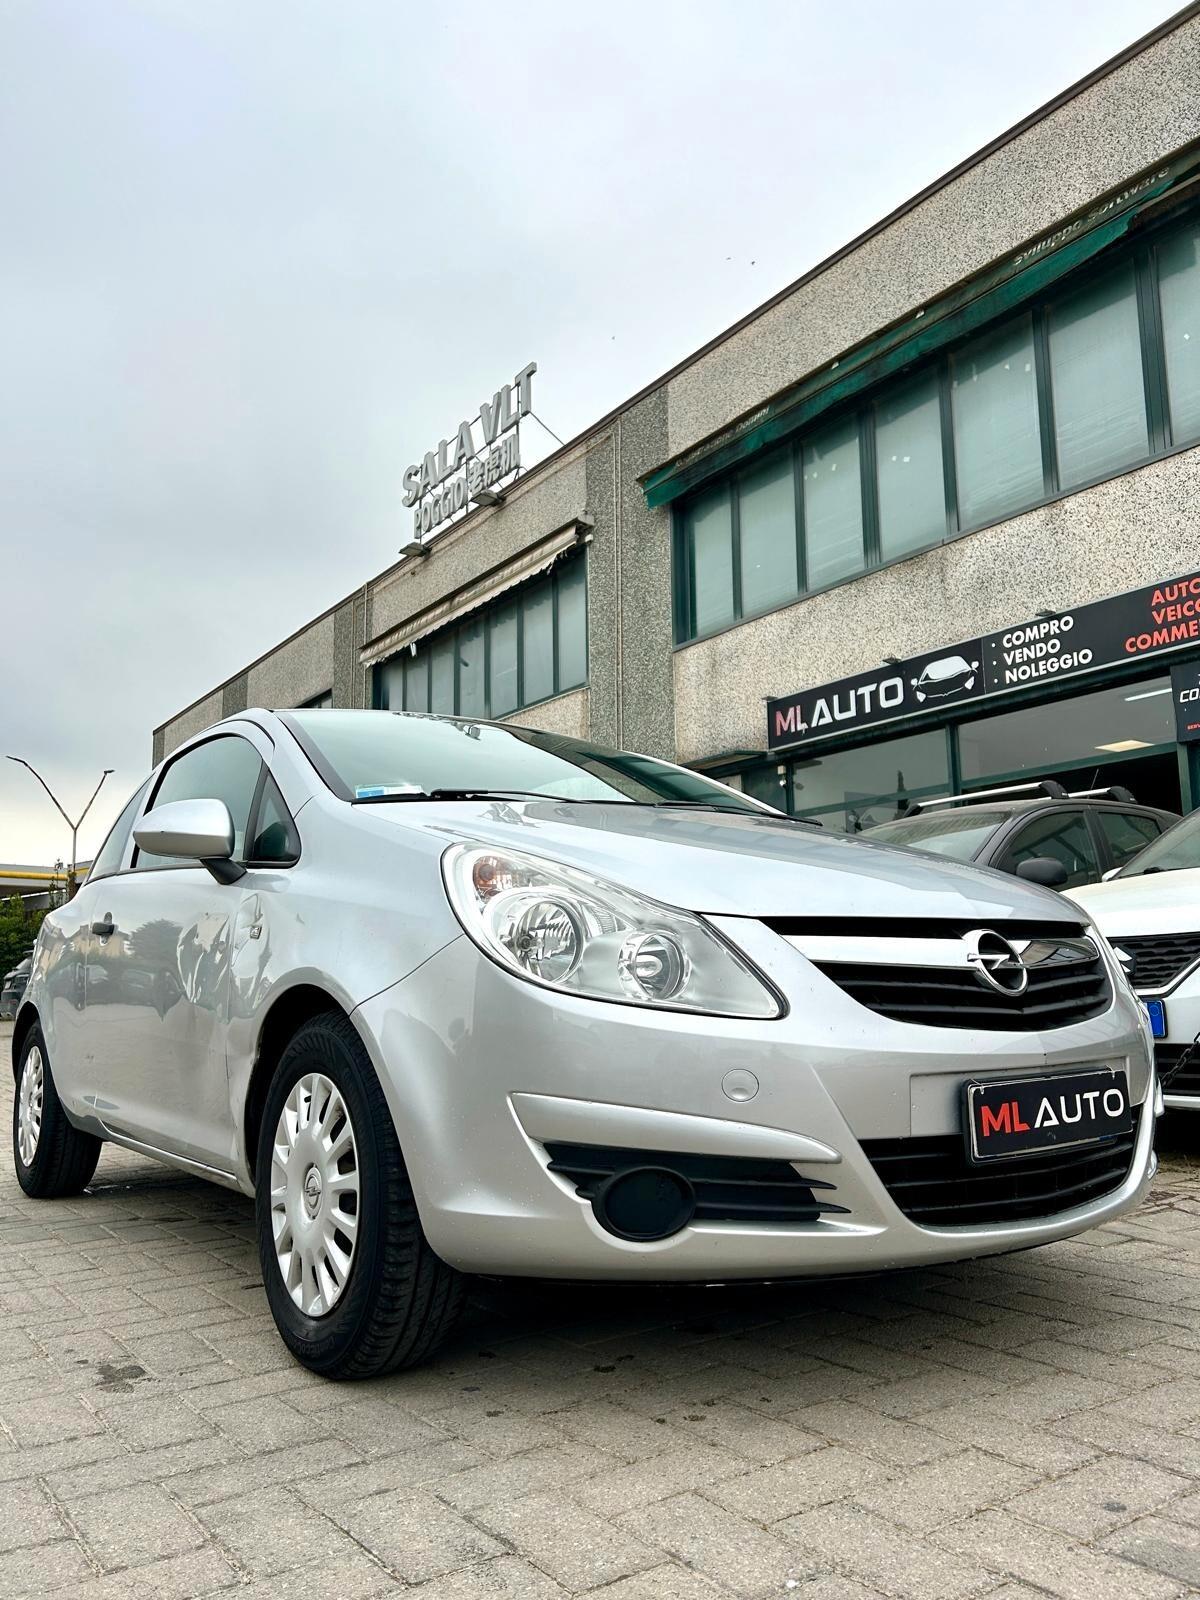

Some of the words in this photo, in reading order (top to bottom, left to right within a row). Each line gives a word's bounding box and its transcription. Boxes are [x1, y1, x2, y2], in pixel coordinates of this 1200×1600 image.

[402, 421, 475, 507] SALA
[480, 361, 537, 445] VLT
[414, 476, 469, 540] POGGIO
[1002, 615, 1074, 650] COMPRO
[1125, 618, 1200, 653] COMME
[1003, 638, 1061, 667] VENDO
[1005, 648, 1093, 685] NOLEGGIO
[775, 704, 809, 737] ML
[810, 676, 904, 729] AUTO
[1180, 687, 1200, 703] CO
[980, 1101, 1031, 1137] ML
[1033, 1088, 1125, 1129] AUTO
